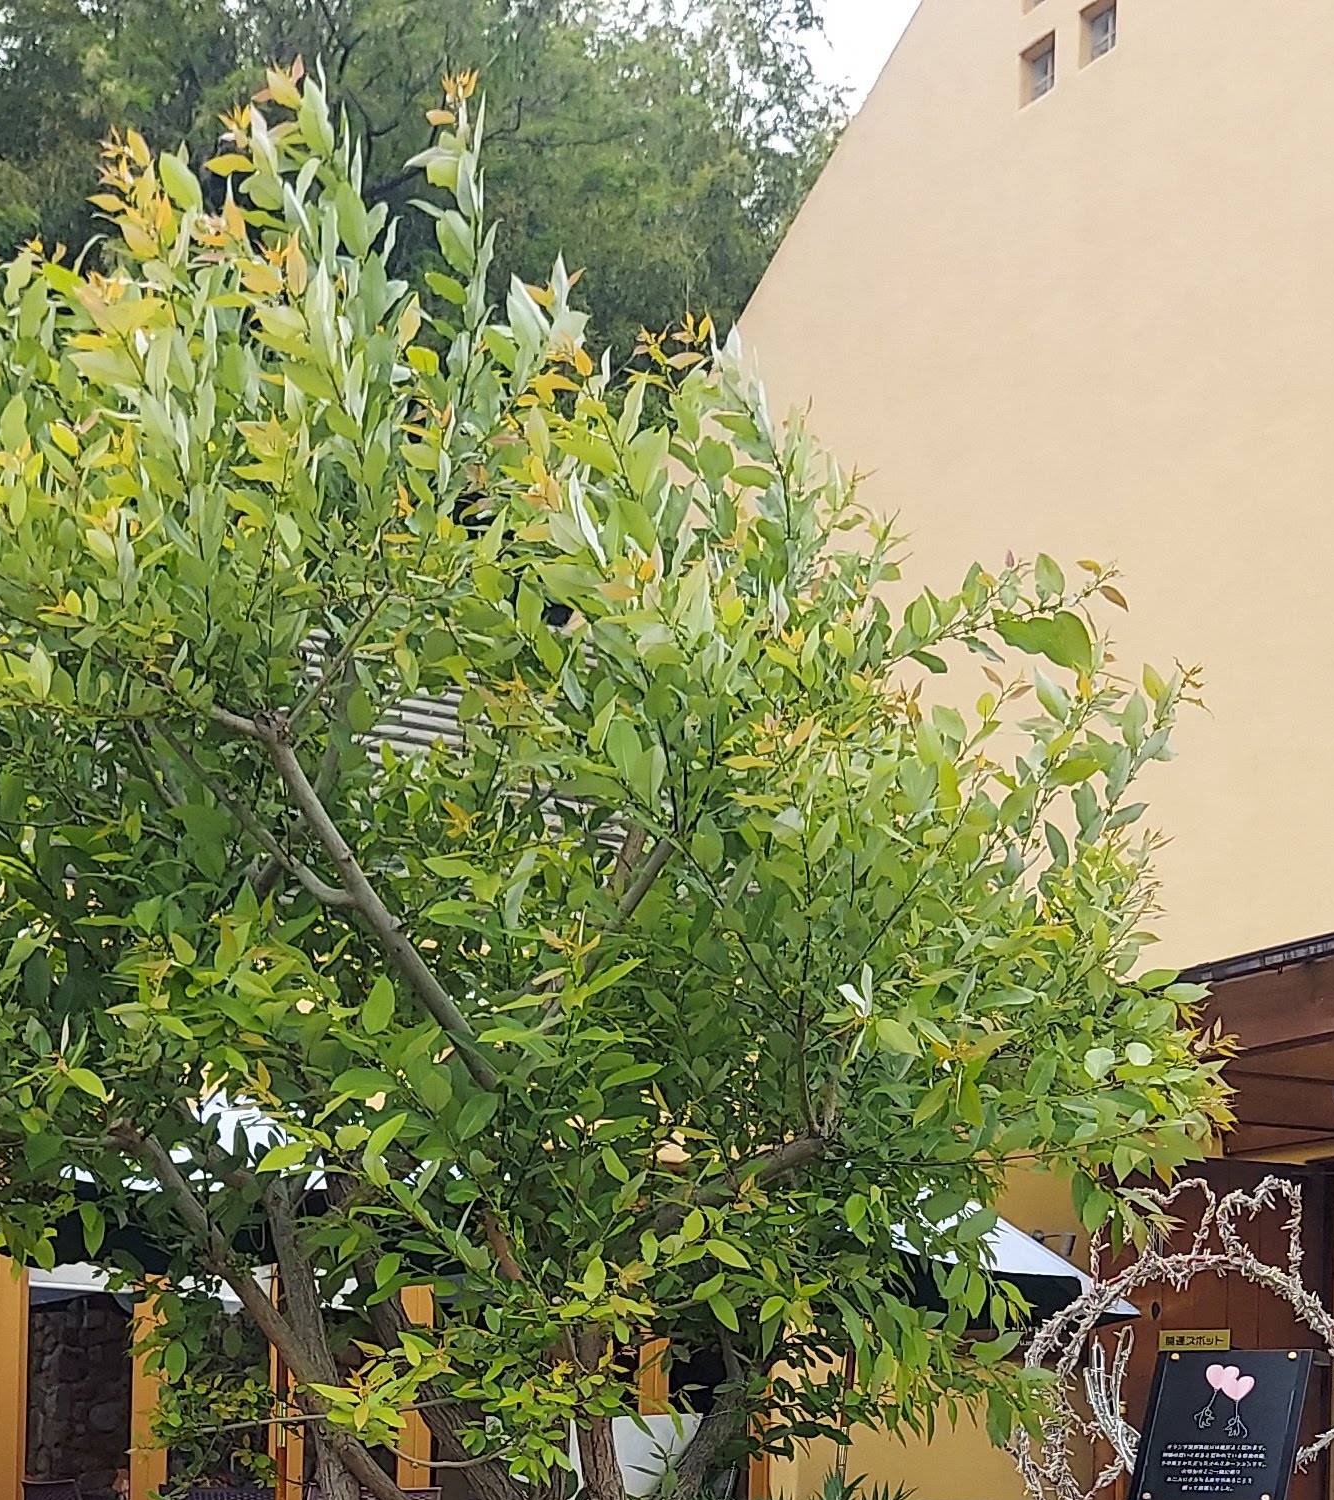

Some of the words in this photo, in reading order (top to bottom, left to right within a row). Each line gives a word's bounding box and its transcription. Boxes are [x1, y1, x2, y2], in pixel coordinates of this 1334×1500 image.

[1165, 1335, 1224, 1346] 開運スポット
